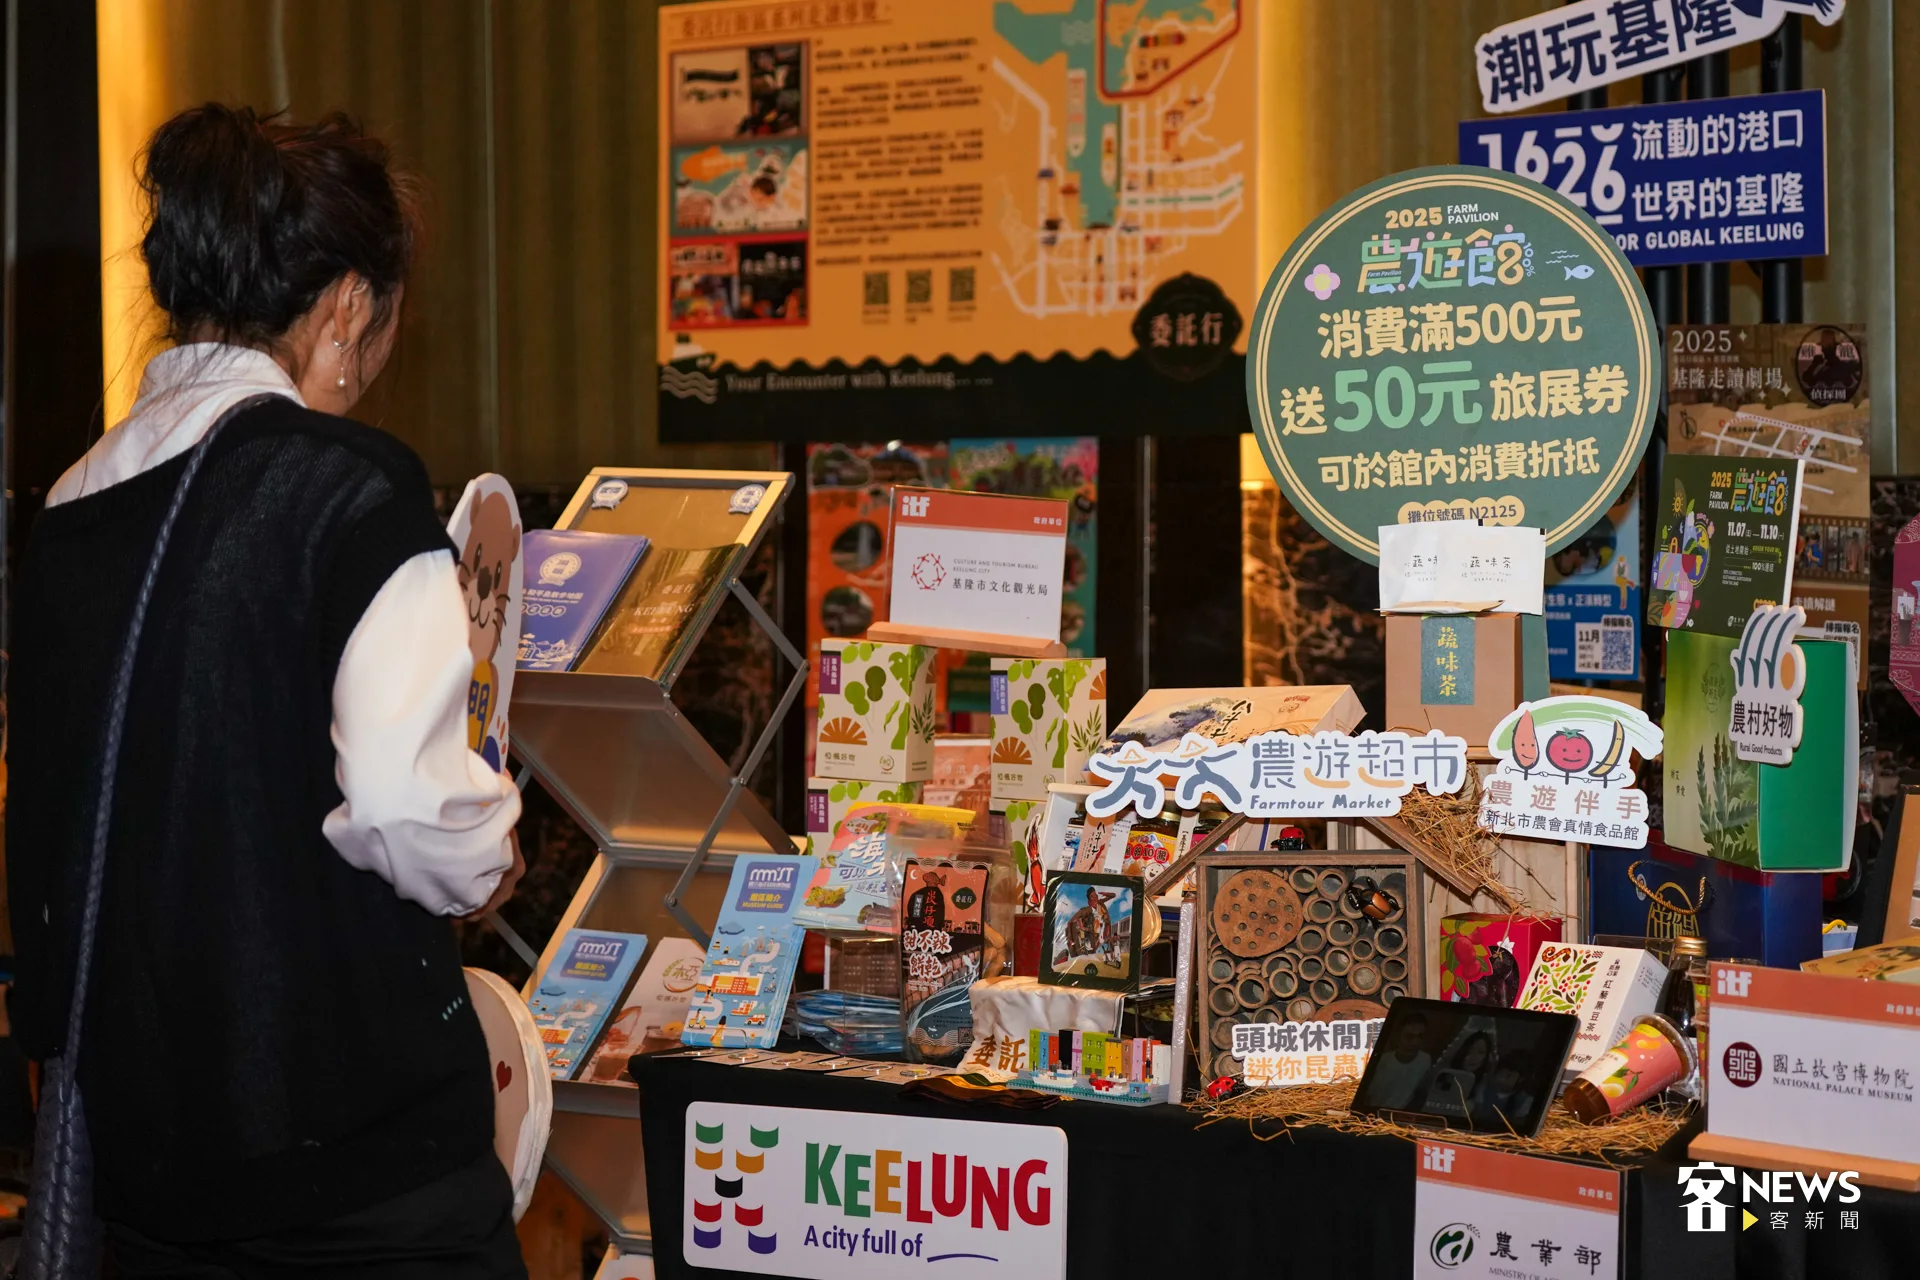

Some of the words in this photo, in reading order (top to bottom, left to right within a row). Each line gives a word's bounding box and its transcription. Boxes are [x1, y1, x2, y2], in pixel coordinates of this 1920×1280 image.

[1482, 0, 1737, 105] 潮玩基隆
[1631, 109, 1803, 161] 流動的港口
[1446, 203, 1479, 215] FARM
[1631, 171, 1804, 223] 世界的基隆
[1385, 206, 1442, 229] 2025
[1447, 211, 1499, 225] PAVILION
[1645, 227, 1715, 249] GLOBAL
[1719, 221, 1804, 245] KEELUNG
[1149, 312, 1224, 347] 委託行
[1316, 295, 1584, 359] 消費滿500元
[1671, 330, 1732, 353] 2025
[1671, 366, 1783, 390] 基隆走讀劇場
[1279, 385, 1328, 436] 送
[1333, 360, 1484, 433] 50元
[1489, 364, 1630, 422] 旅展券
[1317, 436, 1601, 492] 可於館內消費折抵
[1710, 471, 1732, 488] 2025
[901, 495, 930, 518] itf
[1708, 501, 1730, 510] PAVILION
[1709, 491, 1723, 500] FARM
[1407, 507, 1465, 523] 攤位號碼
[1469, 504, 1517, 520] N2125
[952, 578, 1048, 596] 基隆市文化觀光局
[1578, 629, 1600, 643] 11月
[1436, 626, 1459, 697] 蔬味茶
[1730, 700, 1794, 739] 農村好物
[1249, 736, 1459, 789] 農遊超市
[1739, 743, 1751, 754] Rural
[1751, 744, 1763, 755] Good
[1763, 745, 1783, 756] Products
[1249, 794, 1325, 810] Farmtour
[1331, 794, 1392, 810] Market
[1487, 779, 1642, 820] 農遊伴手
[1485, 809, 1640, 842] 新北市農會真情食品館
[903, 929, 952, 954] 甜不辣
[909, 953, 943, 979] 餅乾
[1716, 968, 1753, 998] itf
[1246, 1053, 1370, 1081] 迷你昆蟲
[1773, 1053, 1914, 1090] 國立故宮博物院
[1772, 1076, 1823, 1091] NATIONAL
[1825, 1083, 1864, 1097] PALACE
[1867, 1088, 1913, 1103] MUSEUM
[1423, 1145, 1456, 1174] itf
[803, 1140, 1051, 1232] KEELUNG
[803, 1224, 819, 1247] A
[821, 1225, 859, 1257] city
[861, 1227, 897, 1255] full
[900, 1232, 924, 1258] of
[1489, 1230, 1602, 1276] 農業部
[1488, 1266, 1528, 1280] MINISTRY
